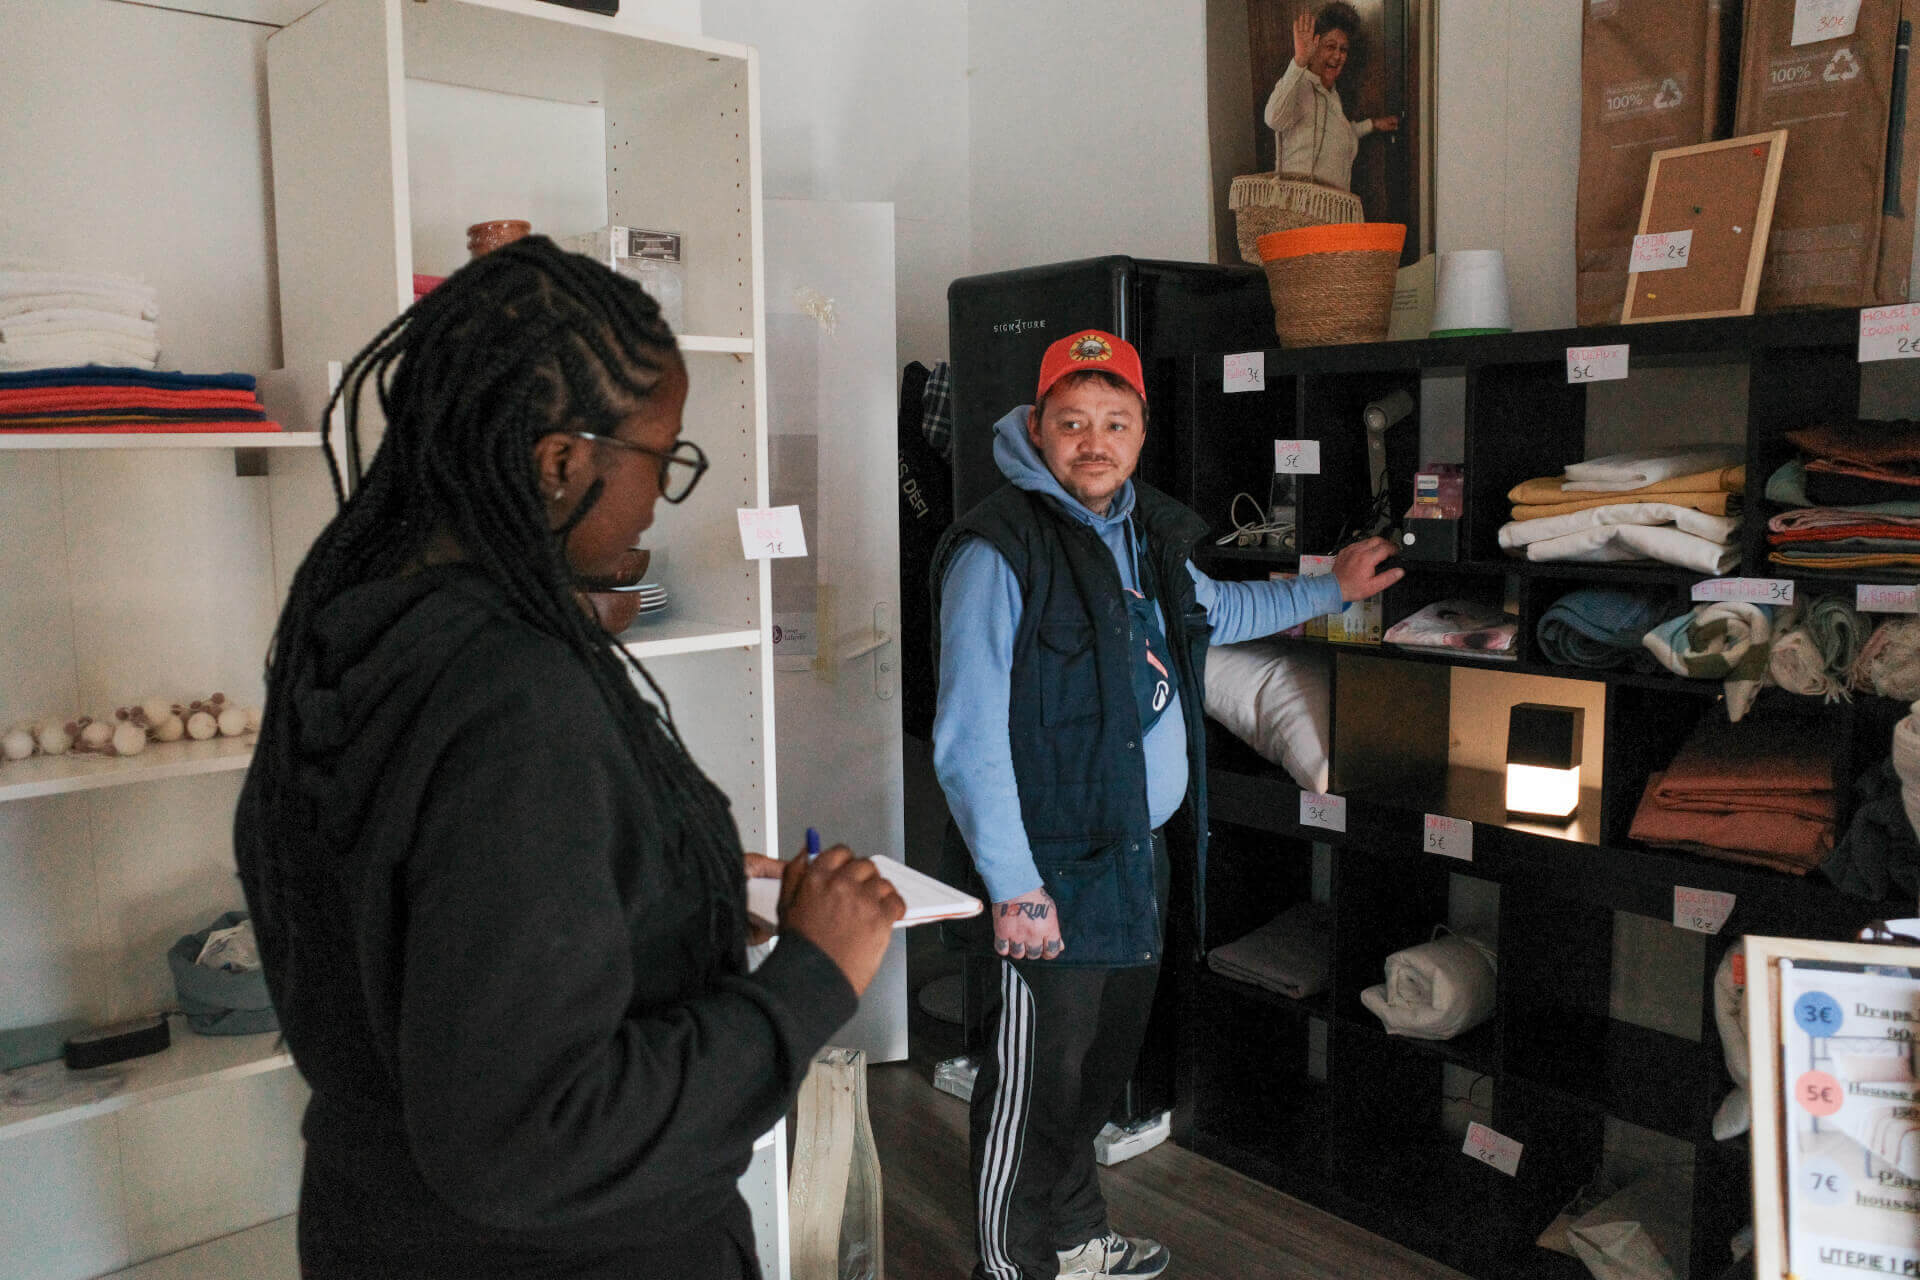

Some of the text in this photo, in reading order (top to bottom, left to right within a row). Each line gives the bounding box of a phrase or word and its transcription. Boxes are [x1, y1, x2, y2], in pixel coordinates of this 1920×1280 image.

[1769, 62, 1812, 84] 100%
[1606, 92, 1643, 111] 100%
[1667, 244, 1688, 259] 2€
[1897, 337, 1920, 353] 2€
[1769, 581, 1792, 601] 3€
[1309, 806, 1328, 822] 3€
[1429, 833, 1446, 850] 5€
[1804, 1004, 1833, 1024] 3€
[1807, 1085, 1833, 1103] 5€
[1810, 1171, 1839, 1193] 7€
